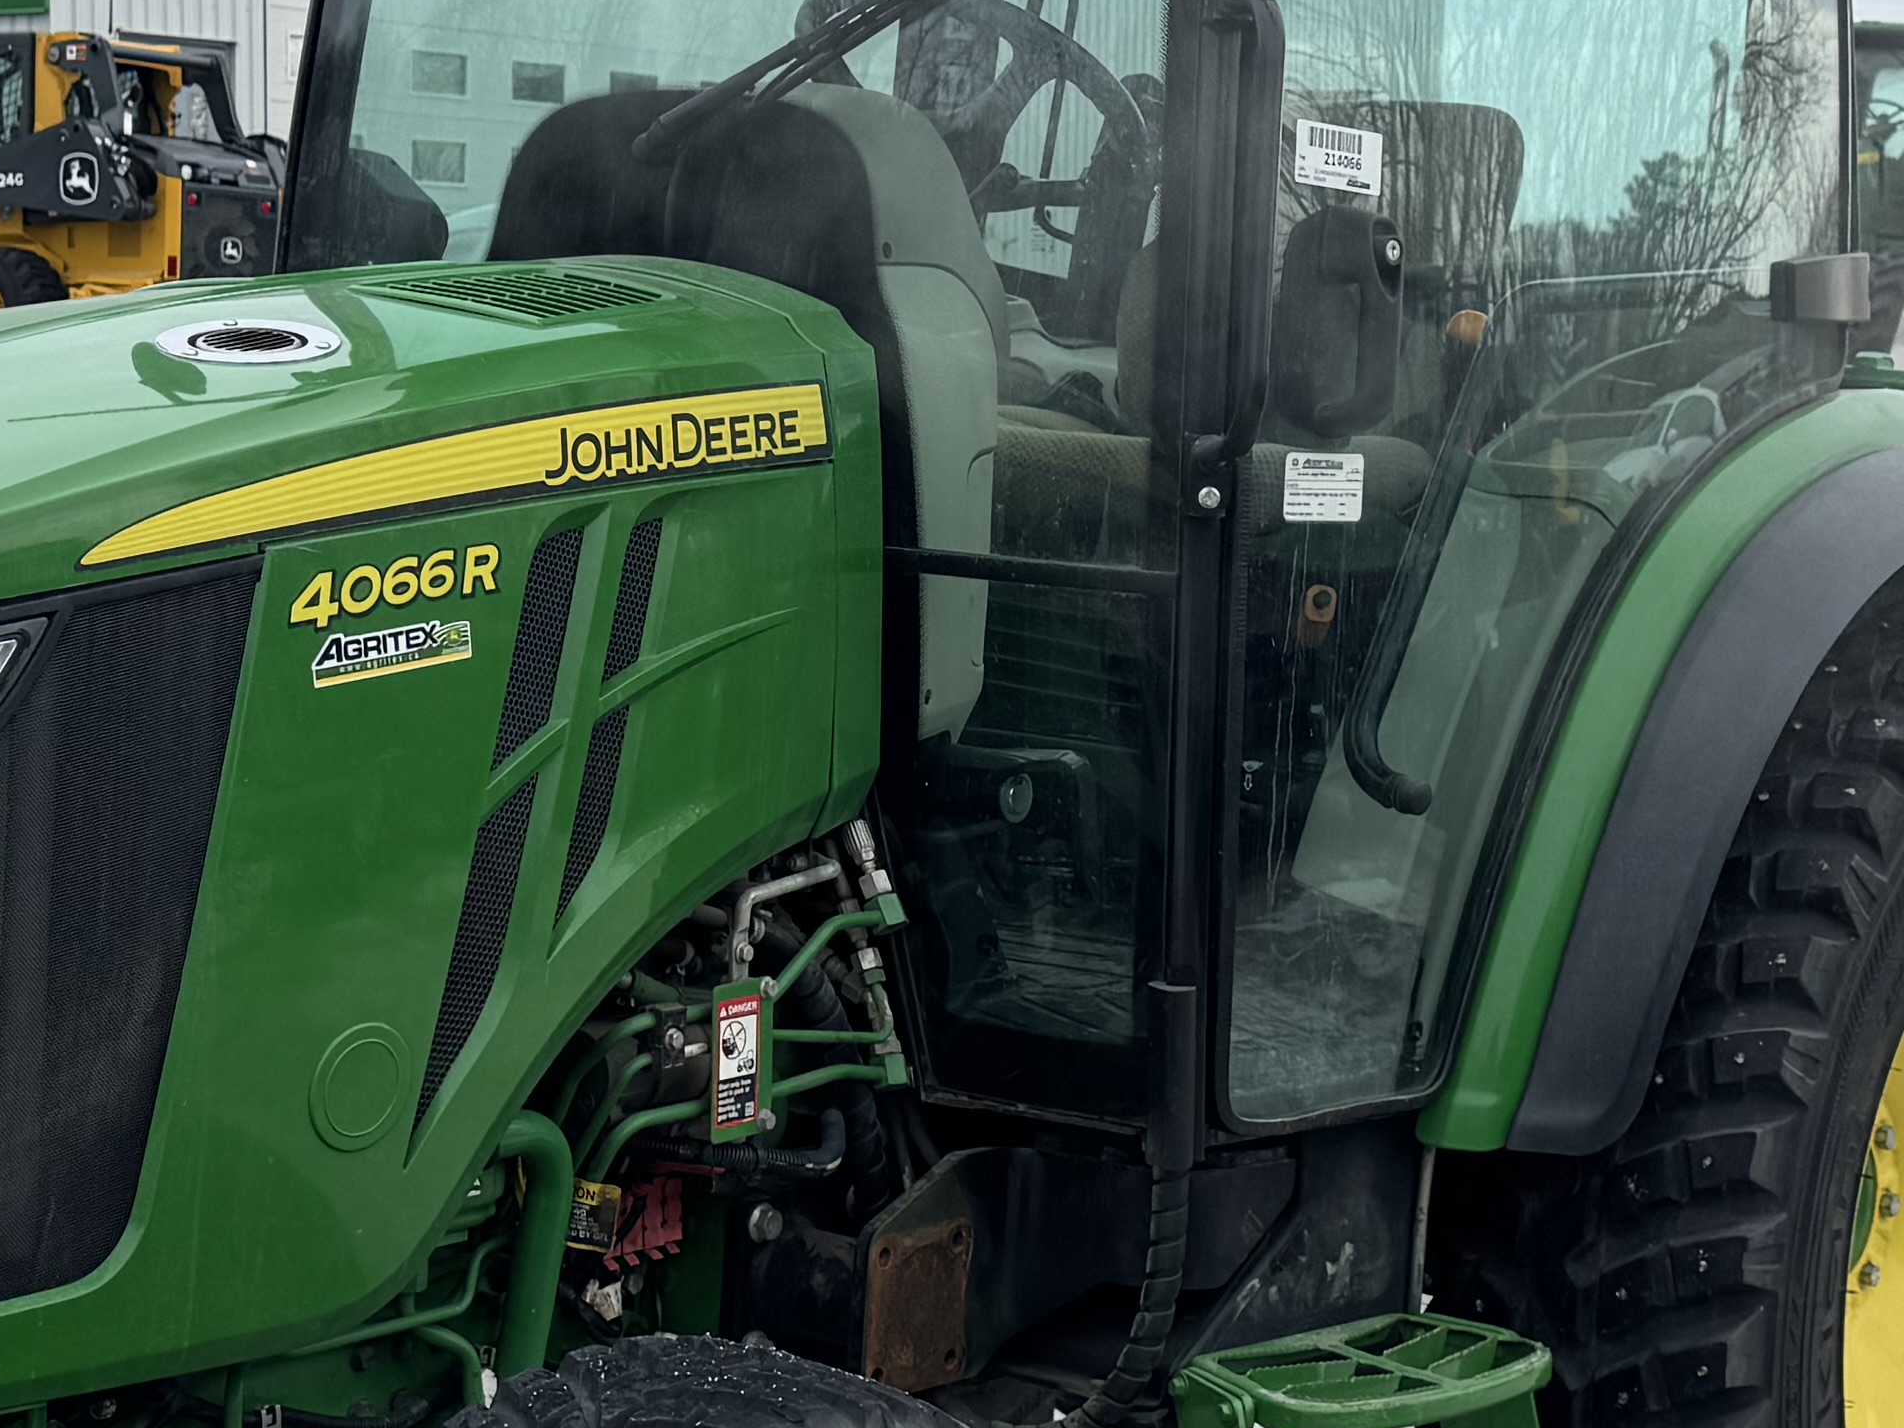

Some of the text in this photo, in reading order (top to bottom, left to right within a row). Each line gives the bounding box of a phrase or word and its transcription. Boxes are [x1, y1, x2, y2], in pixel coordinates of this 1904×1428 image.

[545, 410, 802, 480] JOHN DEERE
[315, 623, 439, 667] AGRITEX
